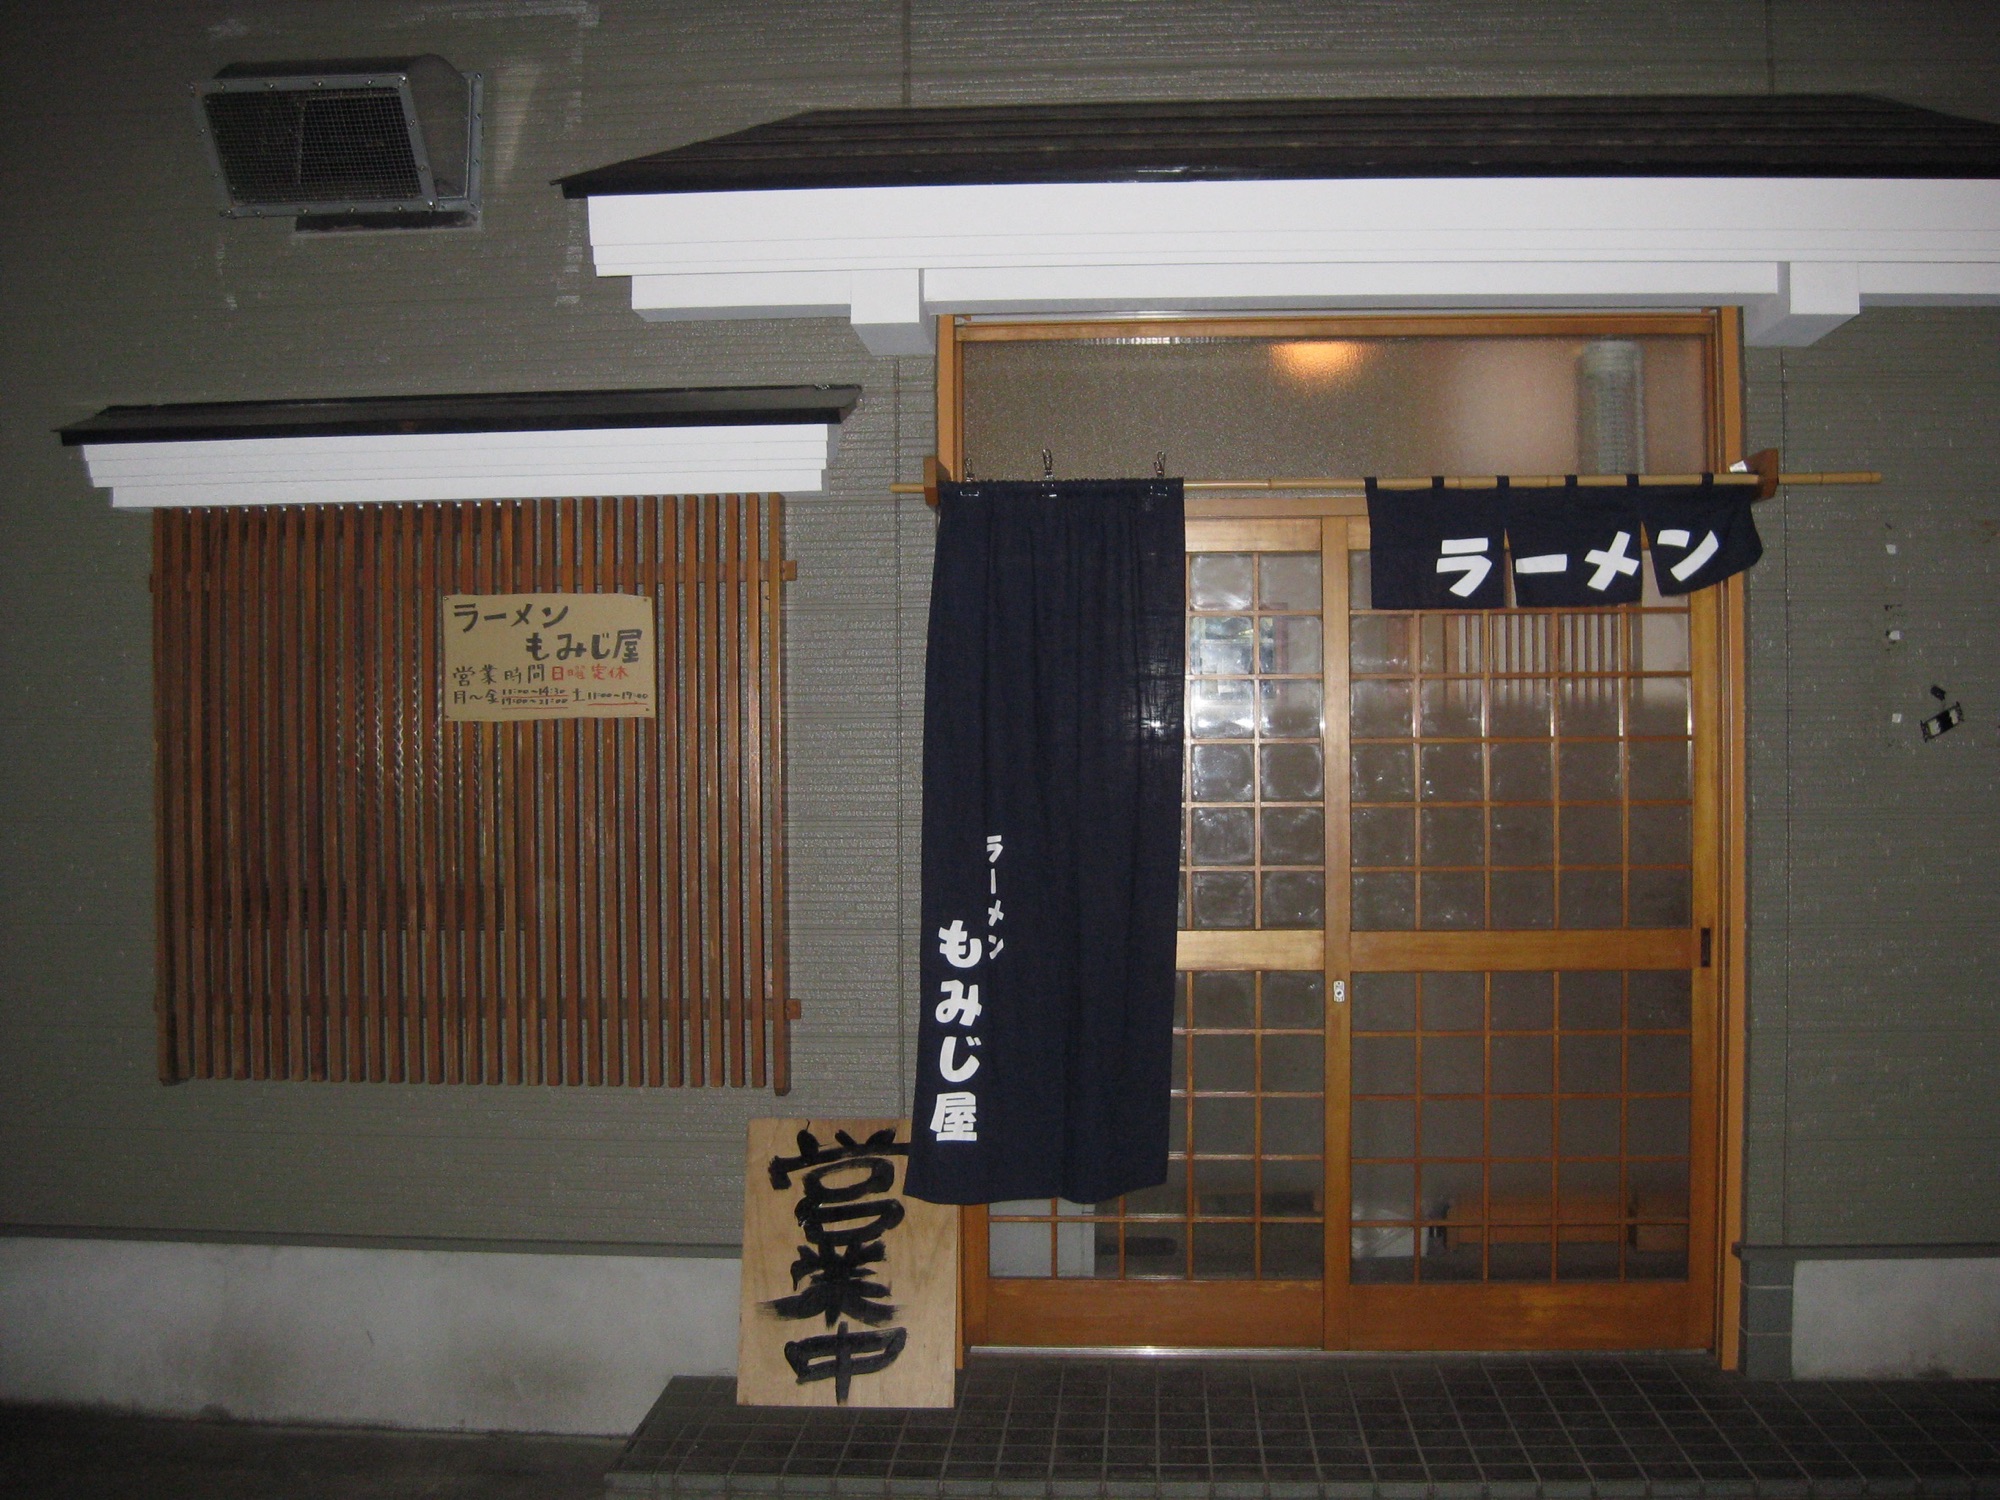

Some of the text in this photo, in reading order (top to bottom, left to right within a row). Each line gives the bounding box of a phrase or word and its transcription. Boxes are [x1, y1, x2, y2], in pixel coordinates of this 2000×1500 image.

[1436, 529, 1719, 598] ラーメン
[454, 603, 569, 633] ラーメン
[526, 629, 643, 664] もみじ屋
[453, 664, 629, 687] 営業時間 日曜定休
[986, 835, 1005, 960] ラーメン
[929, 919, 983, 1142] もみじ屋
[755, 1119, 911, 1406] 営業中
